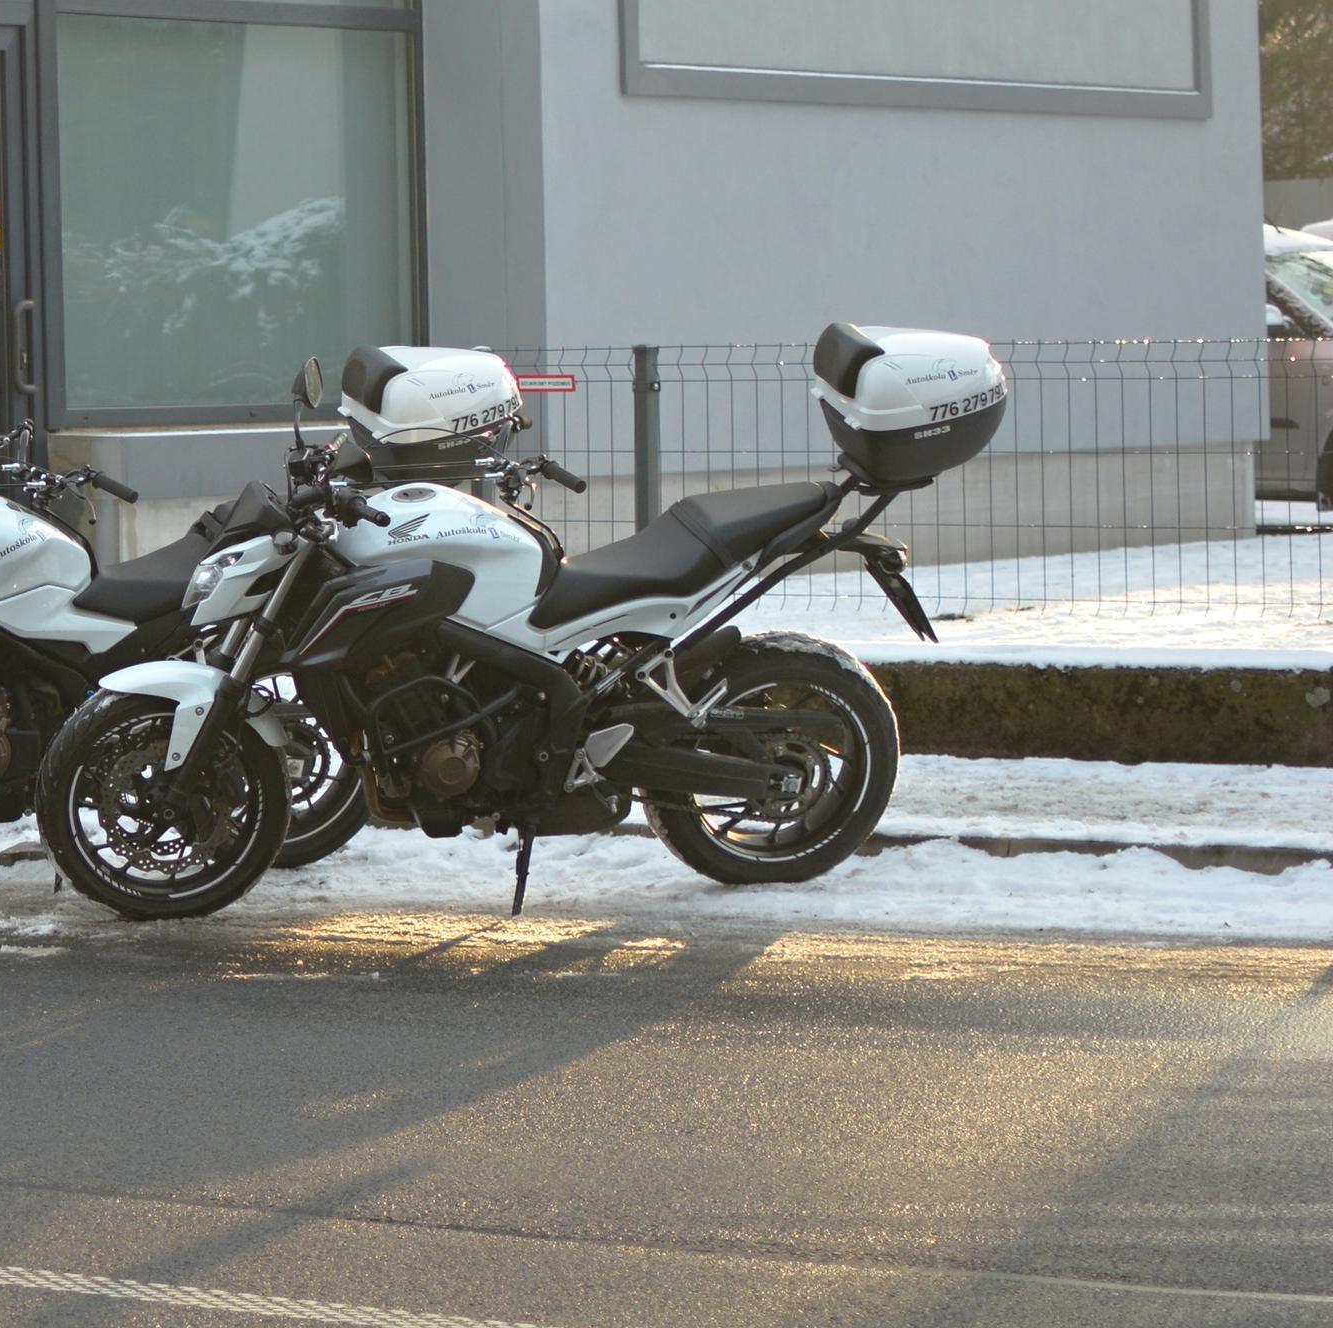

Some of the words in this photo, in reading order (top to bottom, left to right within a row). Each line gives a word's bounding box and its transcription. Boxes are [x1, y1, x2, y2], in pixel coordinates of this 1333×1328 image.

[930, 402, 959, 421] 776
[962, 393, 987, 412] 279
[452, 414, 479, 432] 776
[483, 404, 505, 422] 279
[388, 533, 430, 546] HONDA
[436, 525, 487, 540] Autoškola
